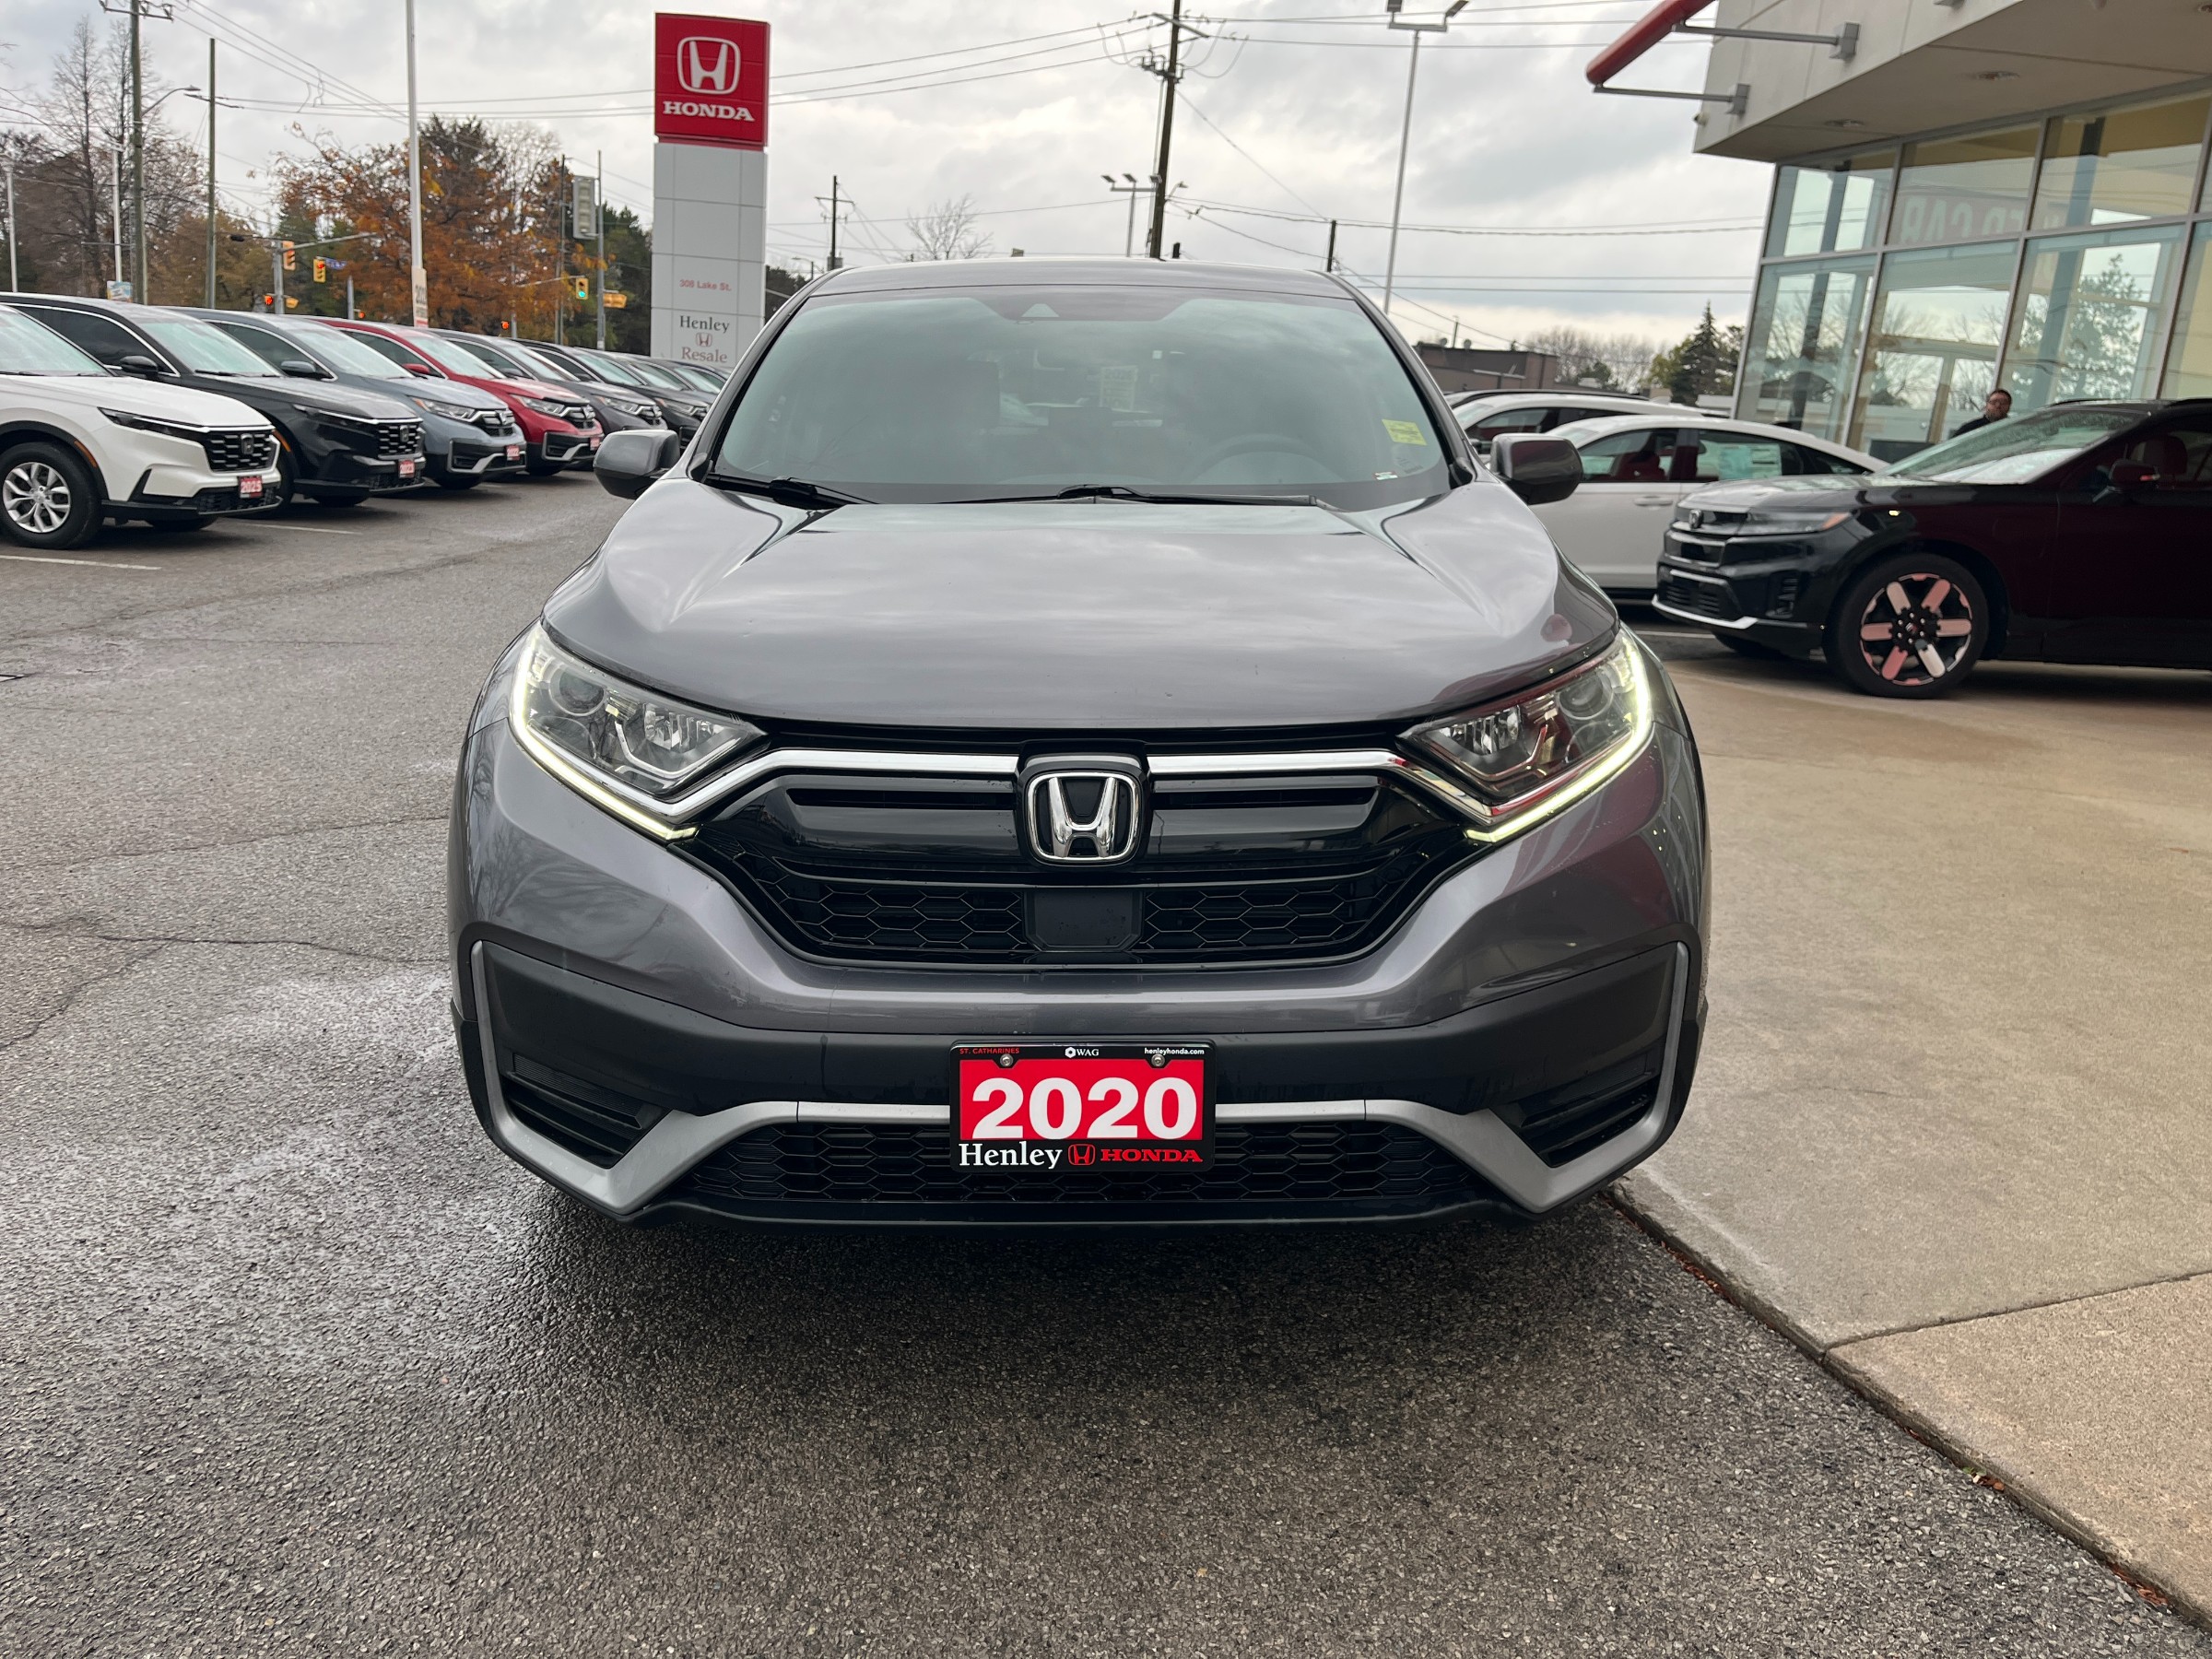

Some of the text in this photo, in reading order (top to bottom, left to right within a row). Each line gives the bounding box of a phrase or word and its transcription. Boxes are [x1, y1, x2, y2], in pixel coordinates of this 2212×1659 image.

[663, 101, 756, 123] HONDA
[697, 280, 717, 290] Lake
[719, 281, 732, 292] St.
[679, 315, 730, 334] Henley
[682, 347, 728, 363] Resale
[959, 1047, 1020, 1055] ST. CATHARINES
[1077, 1048, 1100, 1057] WAG
[1144, 1047, 1205, 1056] henleyhonda.com
[971, 1077, 1198, 1140] 2020
[959, 1141, 1064, 1170] Henley
[1100, 1148, 1204, 1163] HONDA
